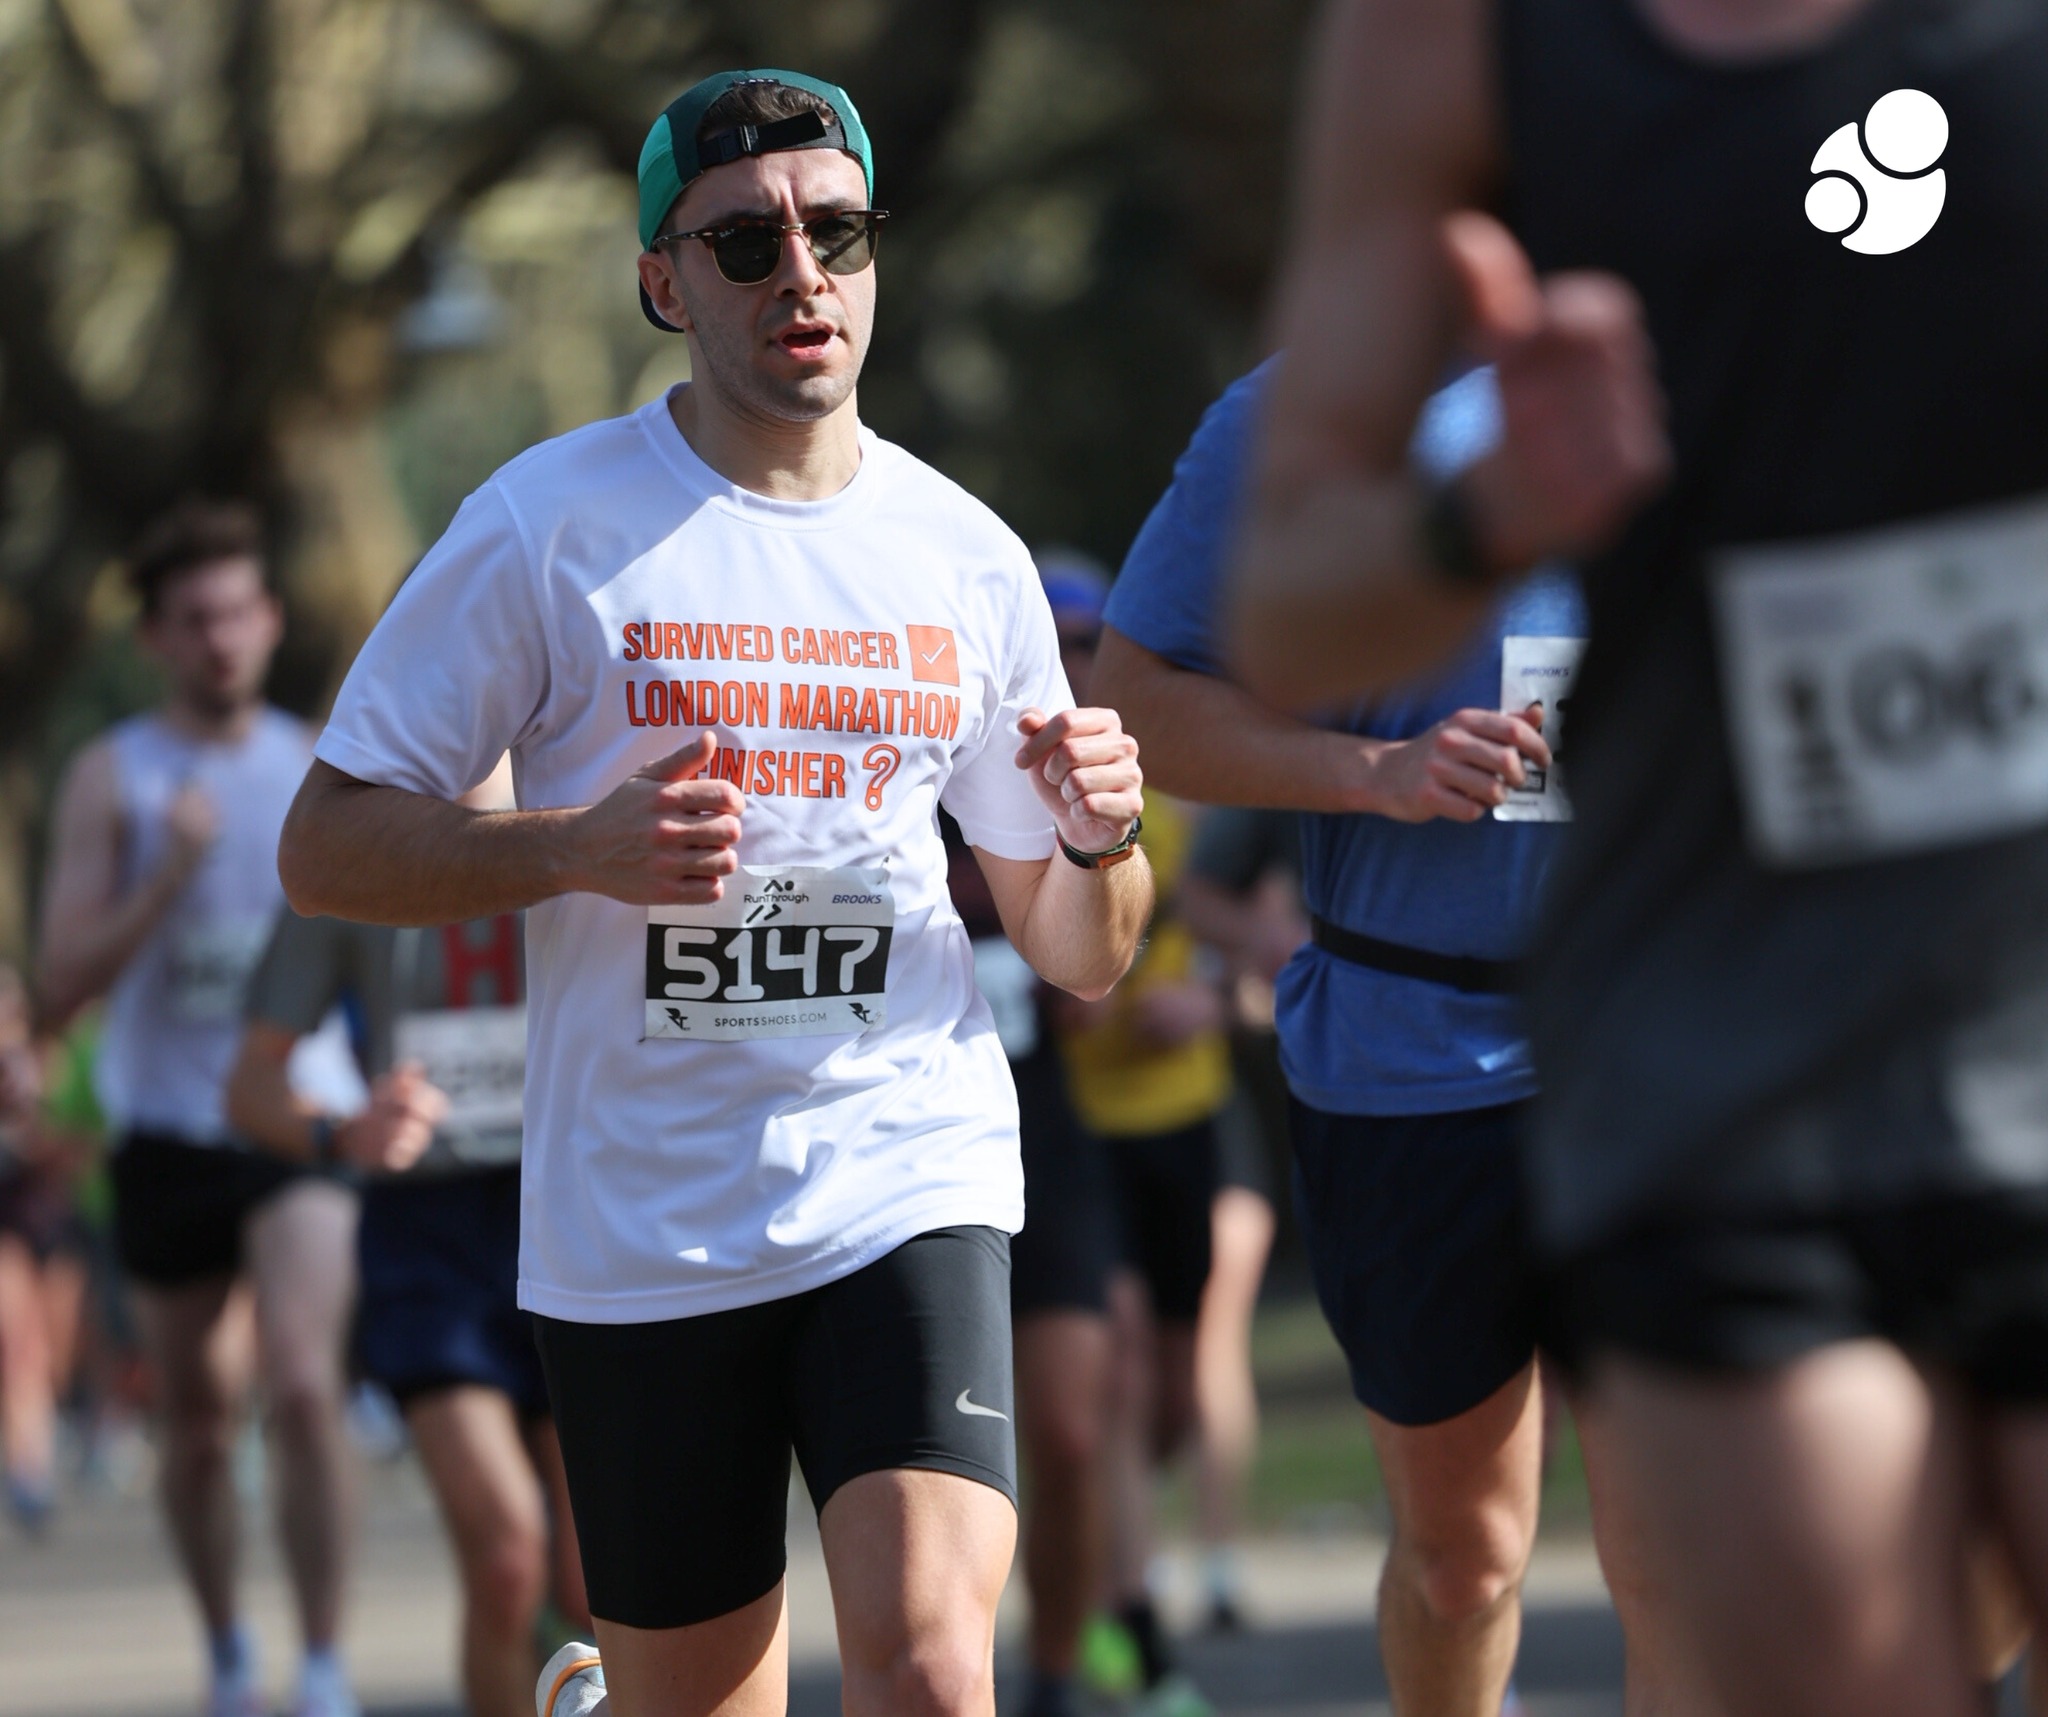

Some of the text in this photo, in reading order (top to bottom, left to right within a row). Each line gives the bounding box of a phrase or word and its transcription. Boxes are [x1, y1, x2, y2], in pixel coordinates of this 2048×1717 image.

[623, 622, 899, 669] SURVIVED CANCER
[1521, 666, 1570, 677] BROOKS
[626, 680, 961, 741] LONDON MARATHON
[689, 746, 846, 798] INISHER
[744, 893, 809, 904] RunThrough
[831, 894, 882, 904] BROOKS
[664, 927, 880, 1001] 5147
[714, 1012, 827, 1028] SPORTSSHOES.COM
